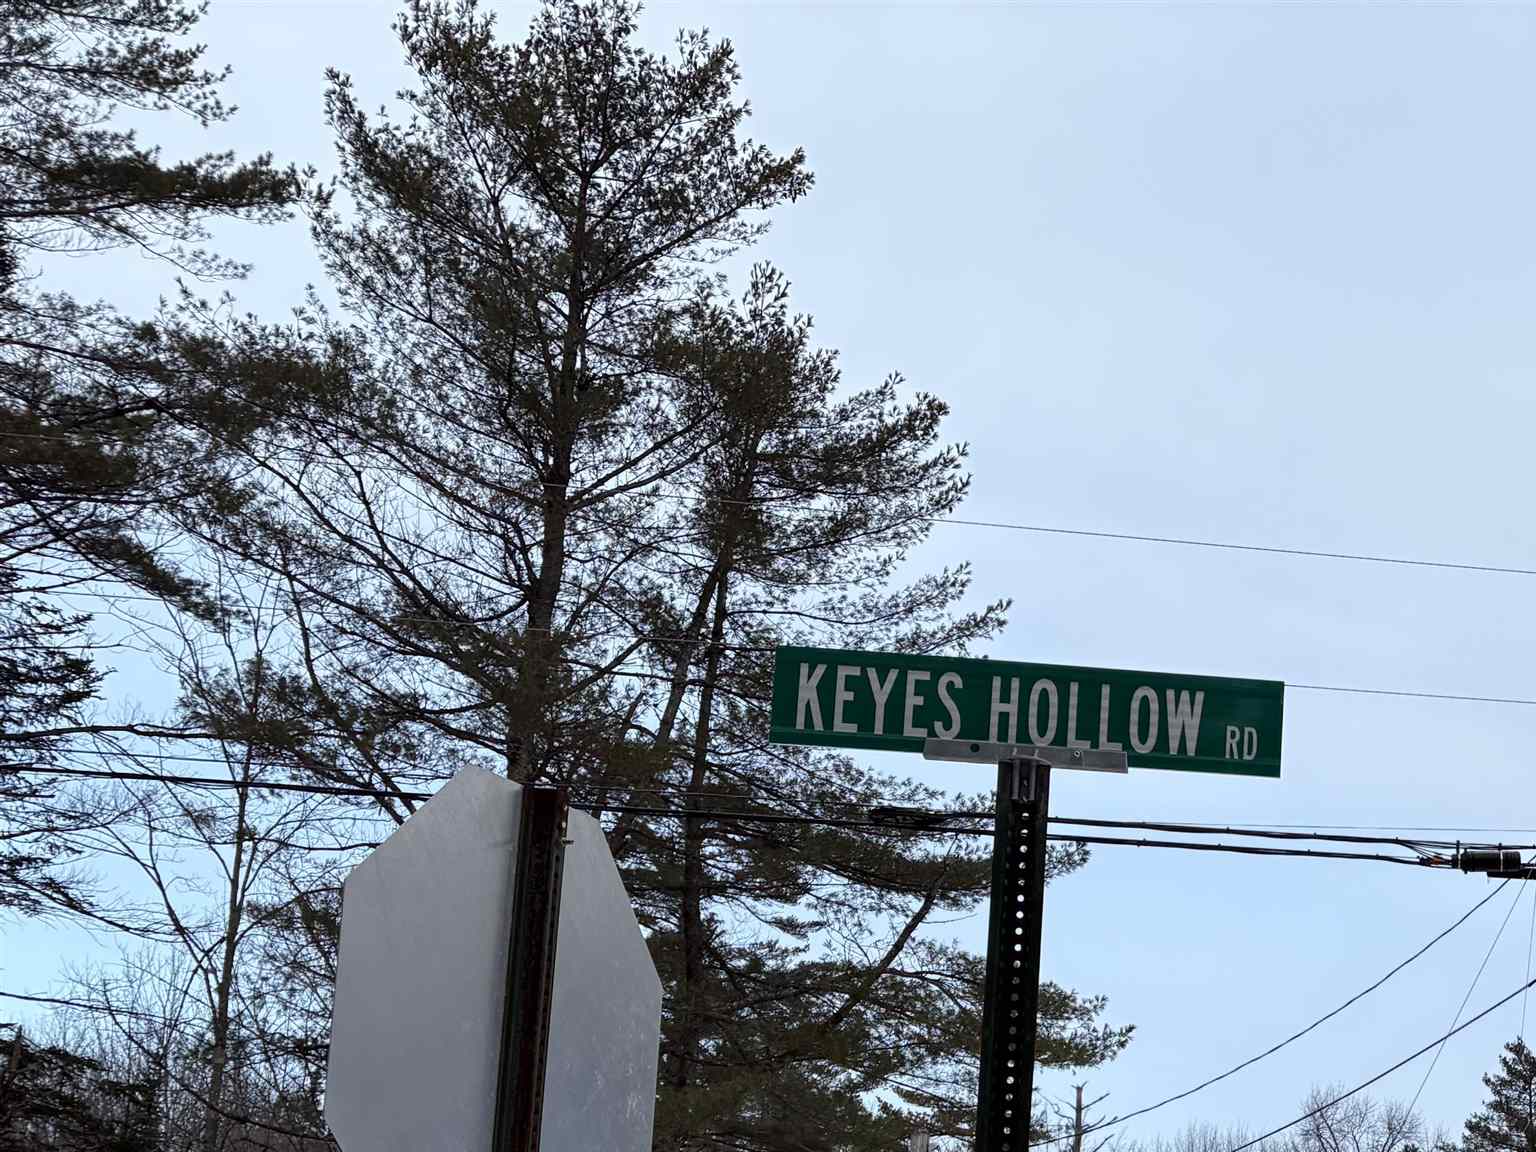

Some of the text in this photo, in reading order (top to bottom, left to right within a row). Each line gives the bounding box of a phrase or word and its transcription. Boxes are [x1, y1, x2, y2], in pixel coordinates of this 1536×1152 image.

[795, 662, 1258, 760] KEYES HOLLOW RD
